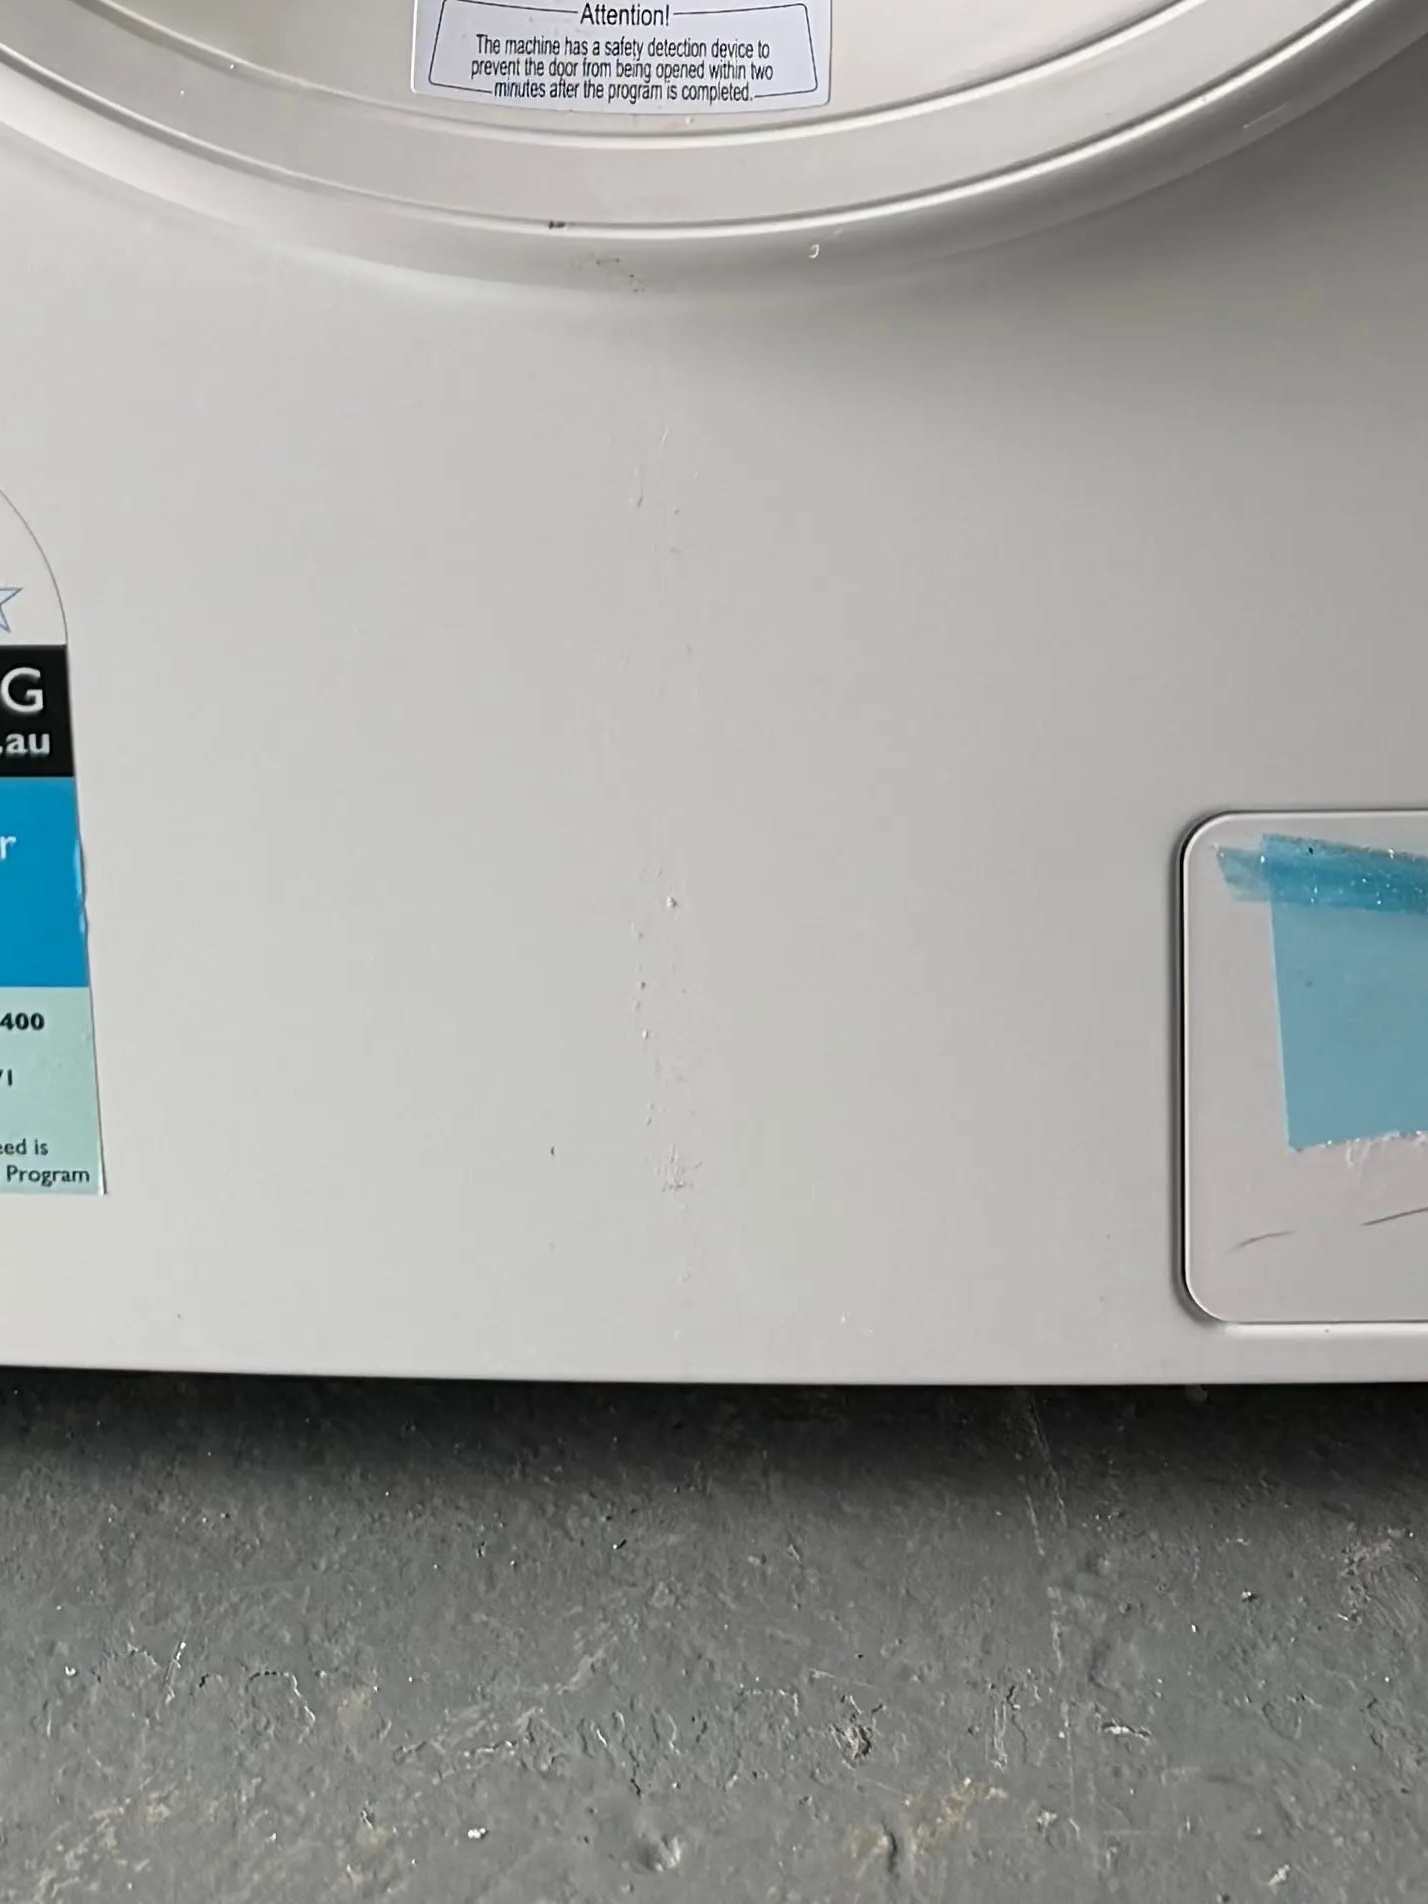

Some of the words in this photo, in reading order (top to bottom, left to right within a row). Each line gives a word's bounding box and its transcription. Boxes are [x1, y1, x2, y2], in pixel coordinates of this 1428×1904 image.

[580, 3, 669, 26] Attention!
[476, 34, 500, 54] The
[505, 36, 560, 55] machine
[565, 37, 588, 55] has
[592, 42, 600, 56] a
[605, 36, 643, 61] safety
[648, 37, 706, 57] detection
[711, 39, 753, 58] device
[758, 40, 769, 59] to
[471, 59, 520, 79] prevent
[525, 57, 544, 76] the
[547, 59, 578, 80] door
[582, 59, 612, 79] from
[616, 59, 651, 83] being
[656, 60, 704, 83] opened
[709, 61, 746, 80] within
[751, 62, 773, 80] two
[495, 79, 545, 98] minutes
[550, 80, 580, 100] after
[584, 79, 604, 99] the
[608, 84, 662, 104] program
[667, 81, 677, 100] is
[682, 81, 752, 105] completed.
[35, 1139, 48, 1155] is
[7, 1165, 89, 1187] Program
